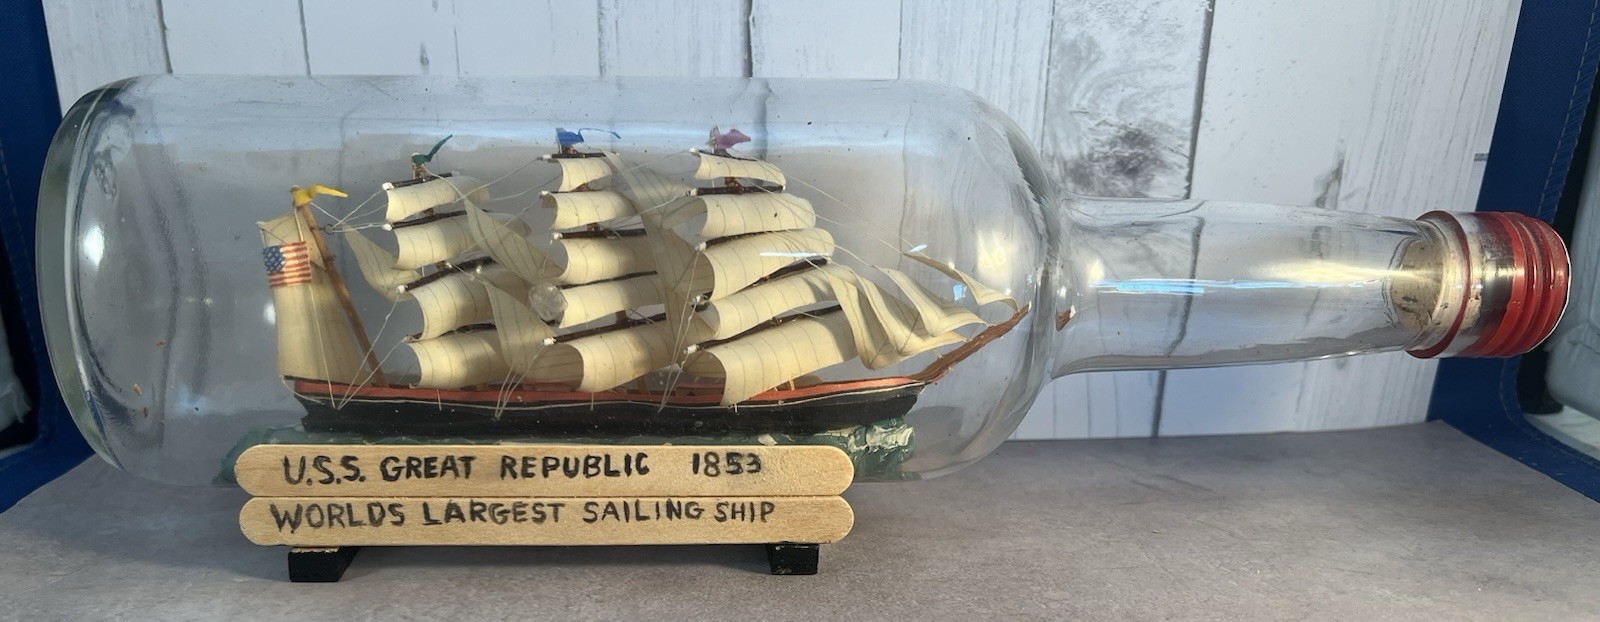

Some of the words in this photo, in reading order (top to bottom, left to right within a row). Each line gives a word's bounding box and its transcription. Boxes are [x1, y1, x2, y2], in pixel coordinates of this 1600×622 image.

[282, 455, 367, 485] U.S.S.
[379, 455, 476, 482] GREAT
[500, 453, 650, 480] REPUBLIC
[691, 452, 762, 477] 1853
[270, 502, 406, 533] WORLDS
[422, 500, 566, 526] LARGEST
[582, 499, 704, 524] SAILING
[713, 500, 775, 523] SHIP
